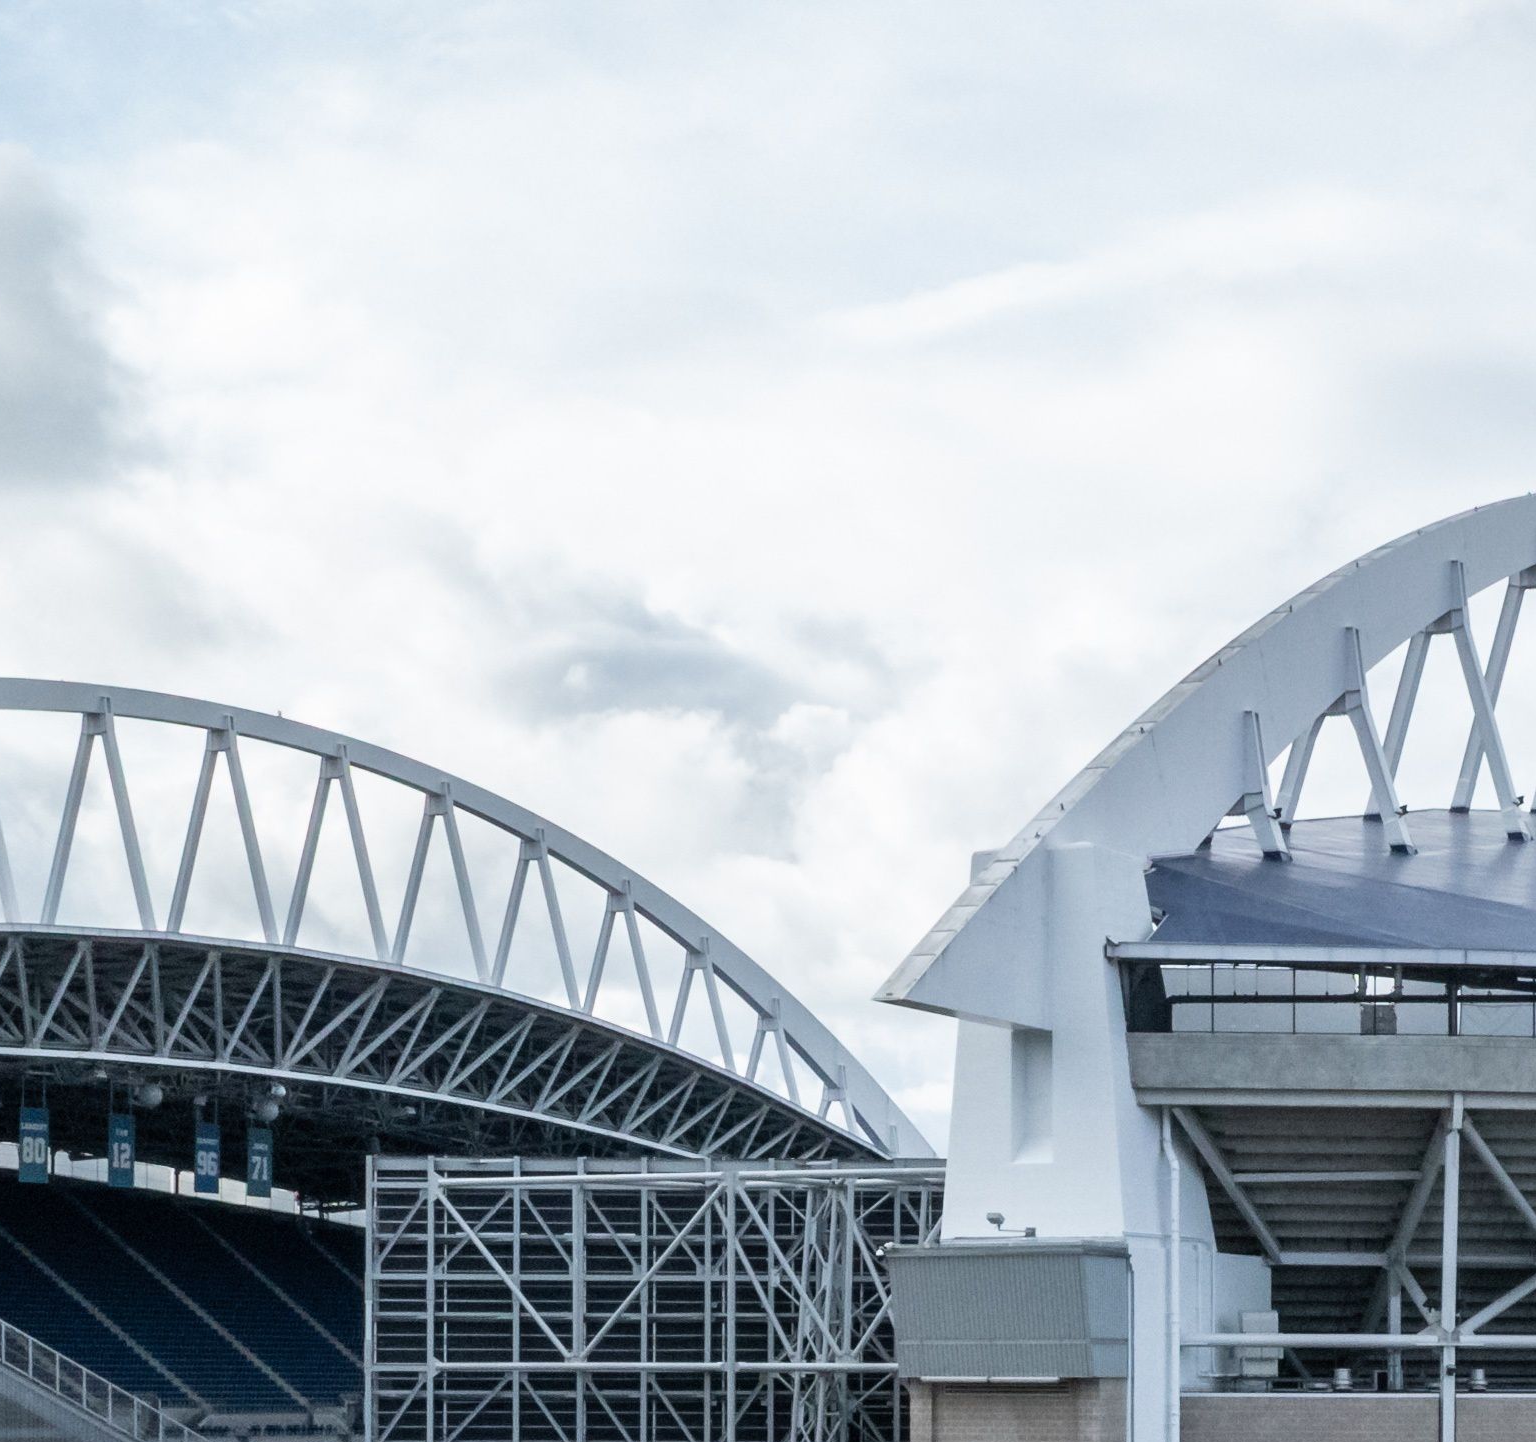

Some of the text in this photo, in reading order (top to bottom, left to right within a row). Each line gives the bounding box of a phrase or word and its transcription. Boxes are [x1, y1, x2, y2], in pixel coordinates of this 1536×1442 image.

[22, 1136, 46, 1164] 80
[113, 1143, 131, 1169] 12
[197, 1151, 218, 1176] 96
[251, 1156, 268, 1181] 71
